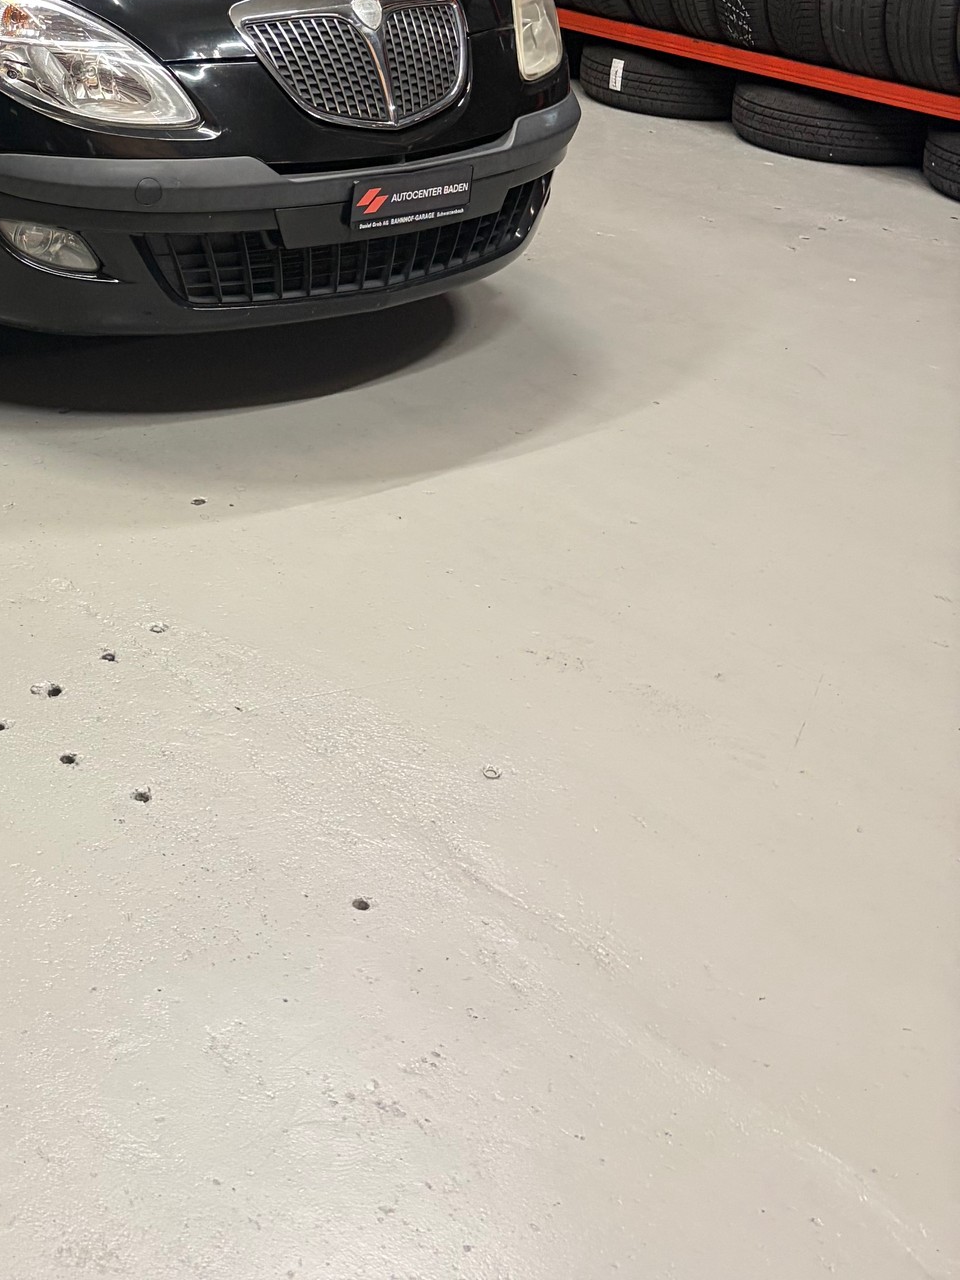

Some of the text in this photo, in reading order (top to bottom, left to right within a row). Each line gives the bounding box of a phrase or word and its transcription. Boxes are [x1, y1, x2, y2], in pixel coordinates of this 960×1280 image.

[391, 182, 469, 203] AUTOCENTER BADEN
[390, 212, 435, 225] BAHNHOF-GARAGE
